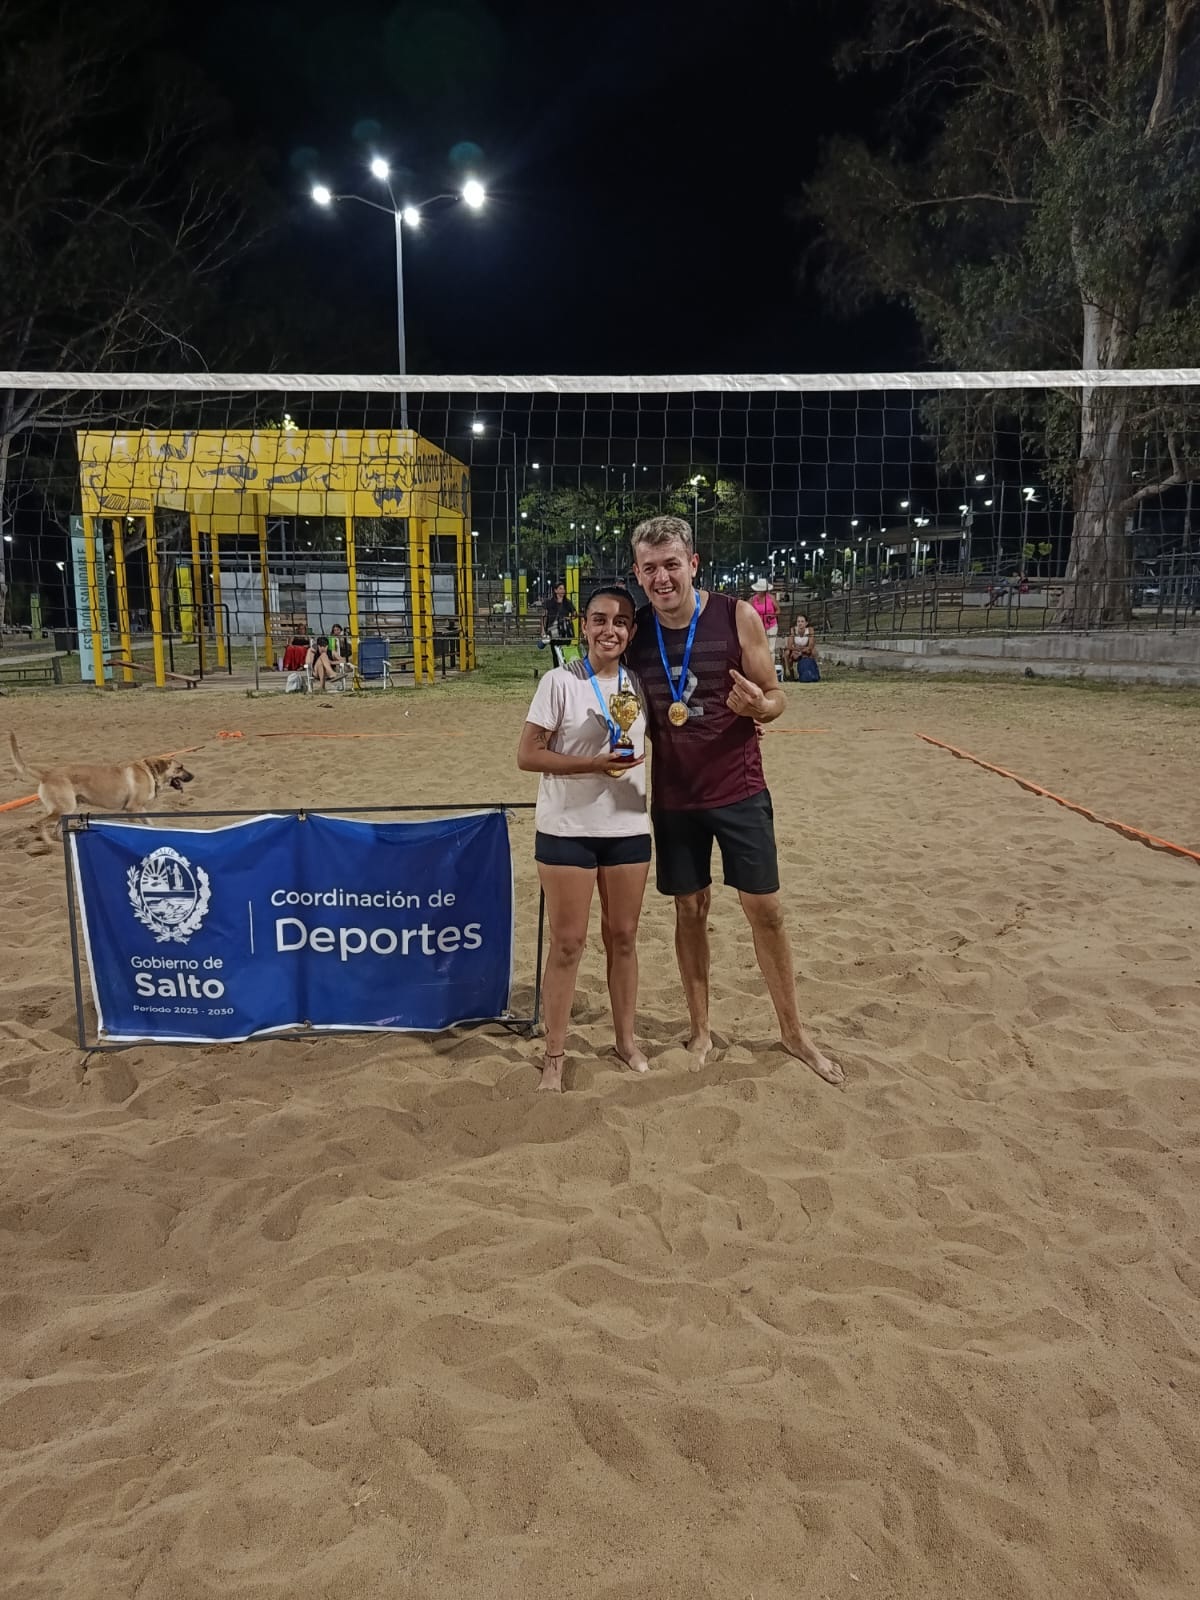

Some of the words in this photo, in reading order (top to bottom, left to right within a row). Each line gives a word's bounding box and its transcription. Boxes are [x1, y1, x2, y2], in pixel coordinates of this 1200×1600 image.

[271, 888, 420, 909] Coordinación
[428, 889, 456, 908] de
[275, 917, 483, 962] Deportes
[130, 955, 199, 969] Gobierno
[202, 955, 223, 970] de
[135, 972, 225, 999] Salto
[174, 1006, 199, 1015] 2025
[207, 1007, 234, 1016] 2030
